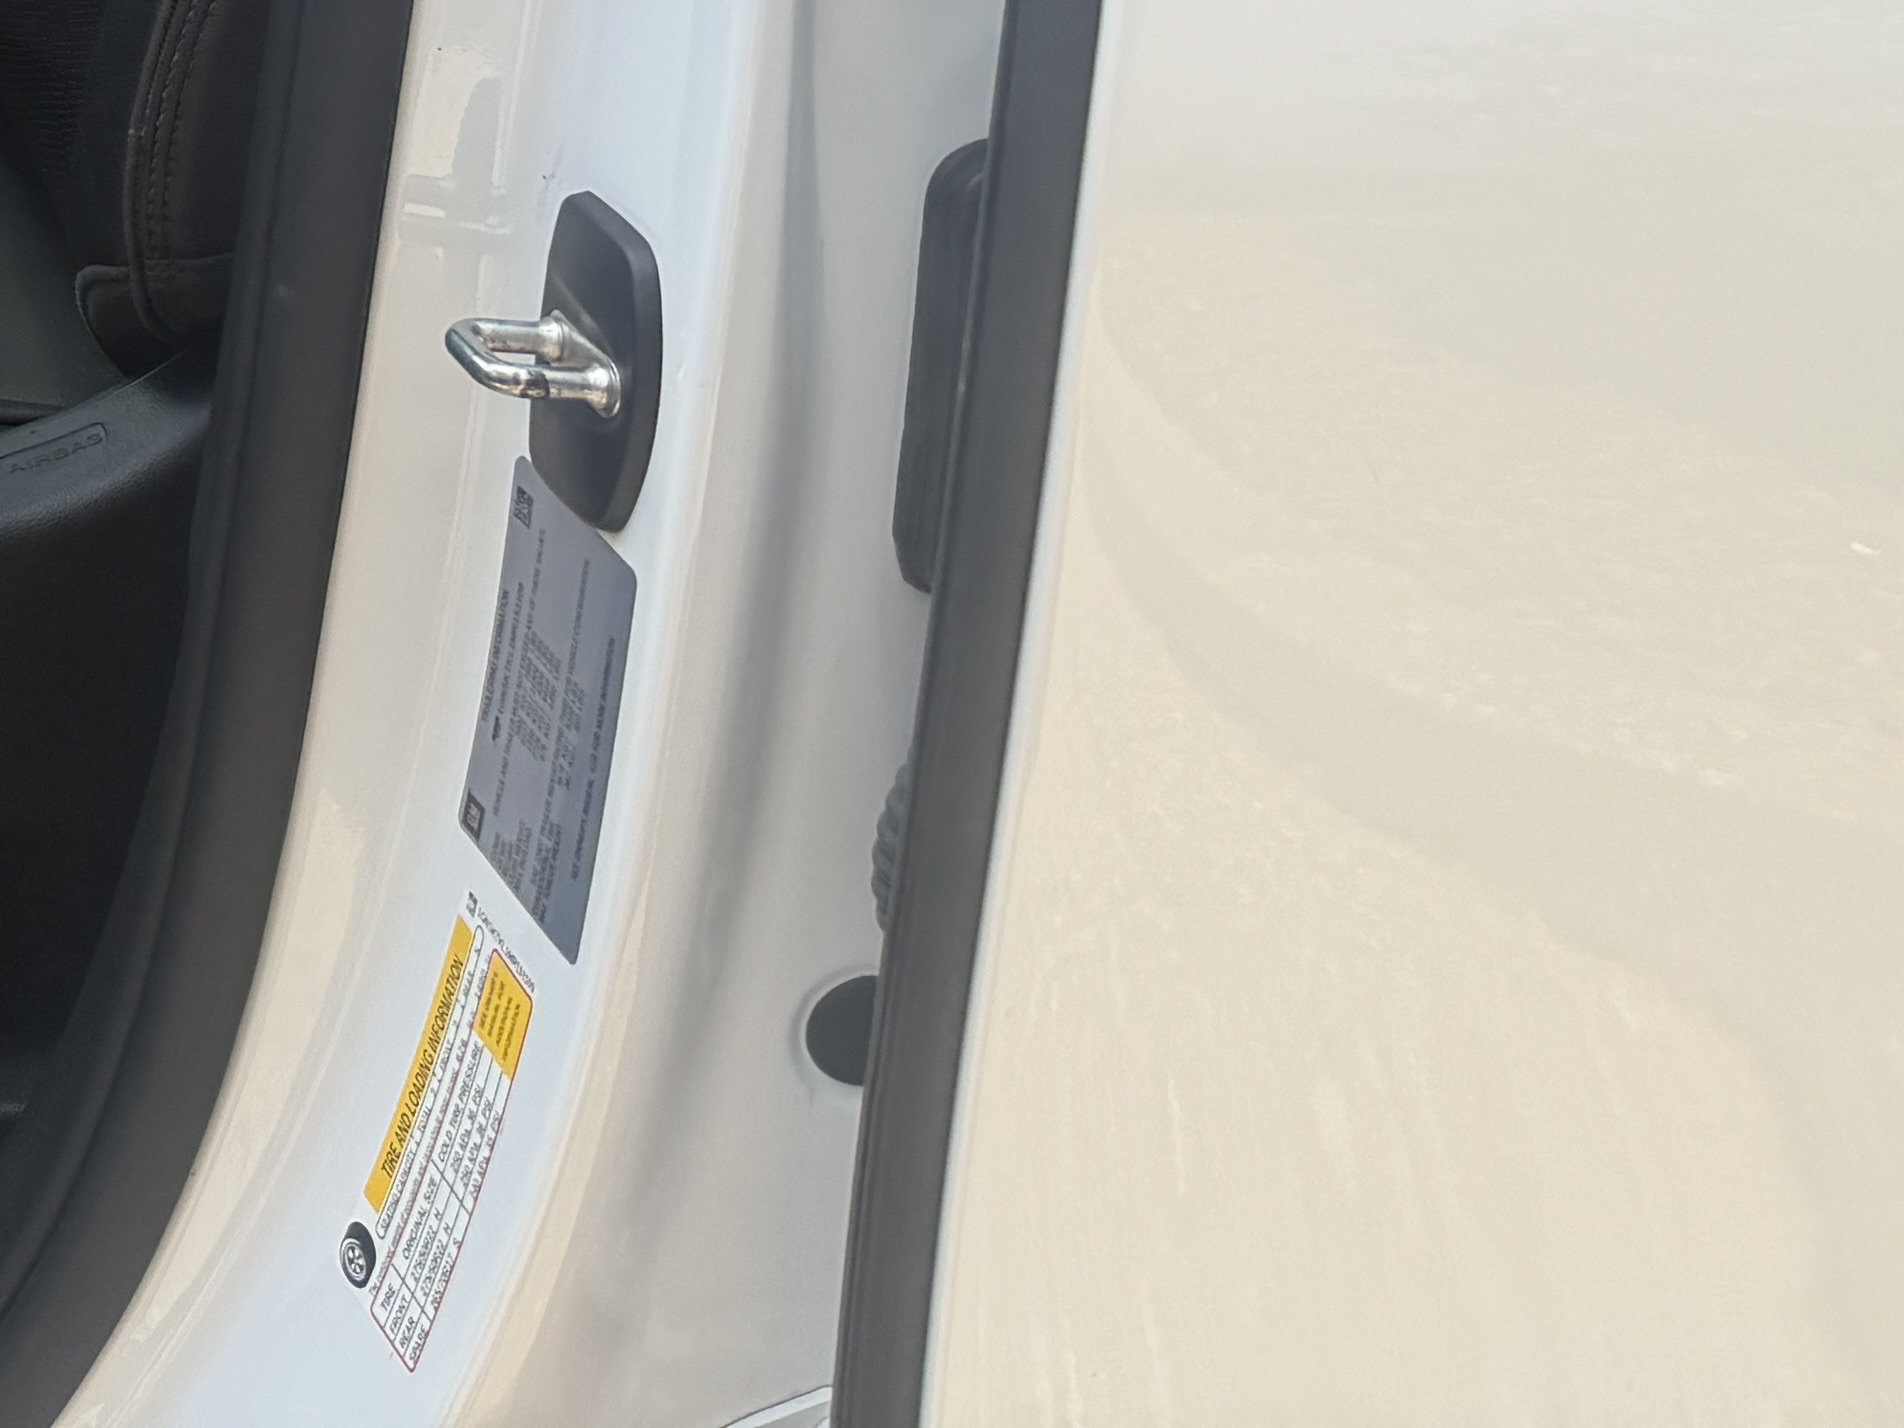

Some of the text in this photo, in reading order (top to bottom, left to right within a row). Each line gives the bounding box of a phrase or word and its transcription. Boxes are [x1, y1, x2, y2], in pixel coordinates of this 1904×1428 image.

[8, 433, 104, 475] AIRBAG
[380, 1140, 401, 1180] TIRE
[393, 1109, 412, 1148] AND
[404, 1046, 434, 1117] LOADING
[426, 952, 464, 1055] INFORMATION
[381, 1283, 394, 1312] TIRE
